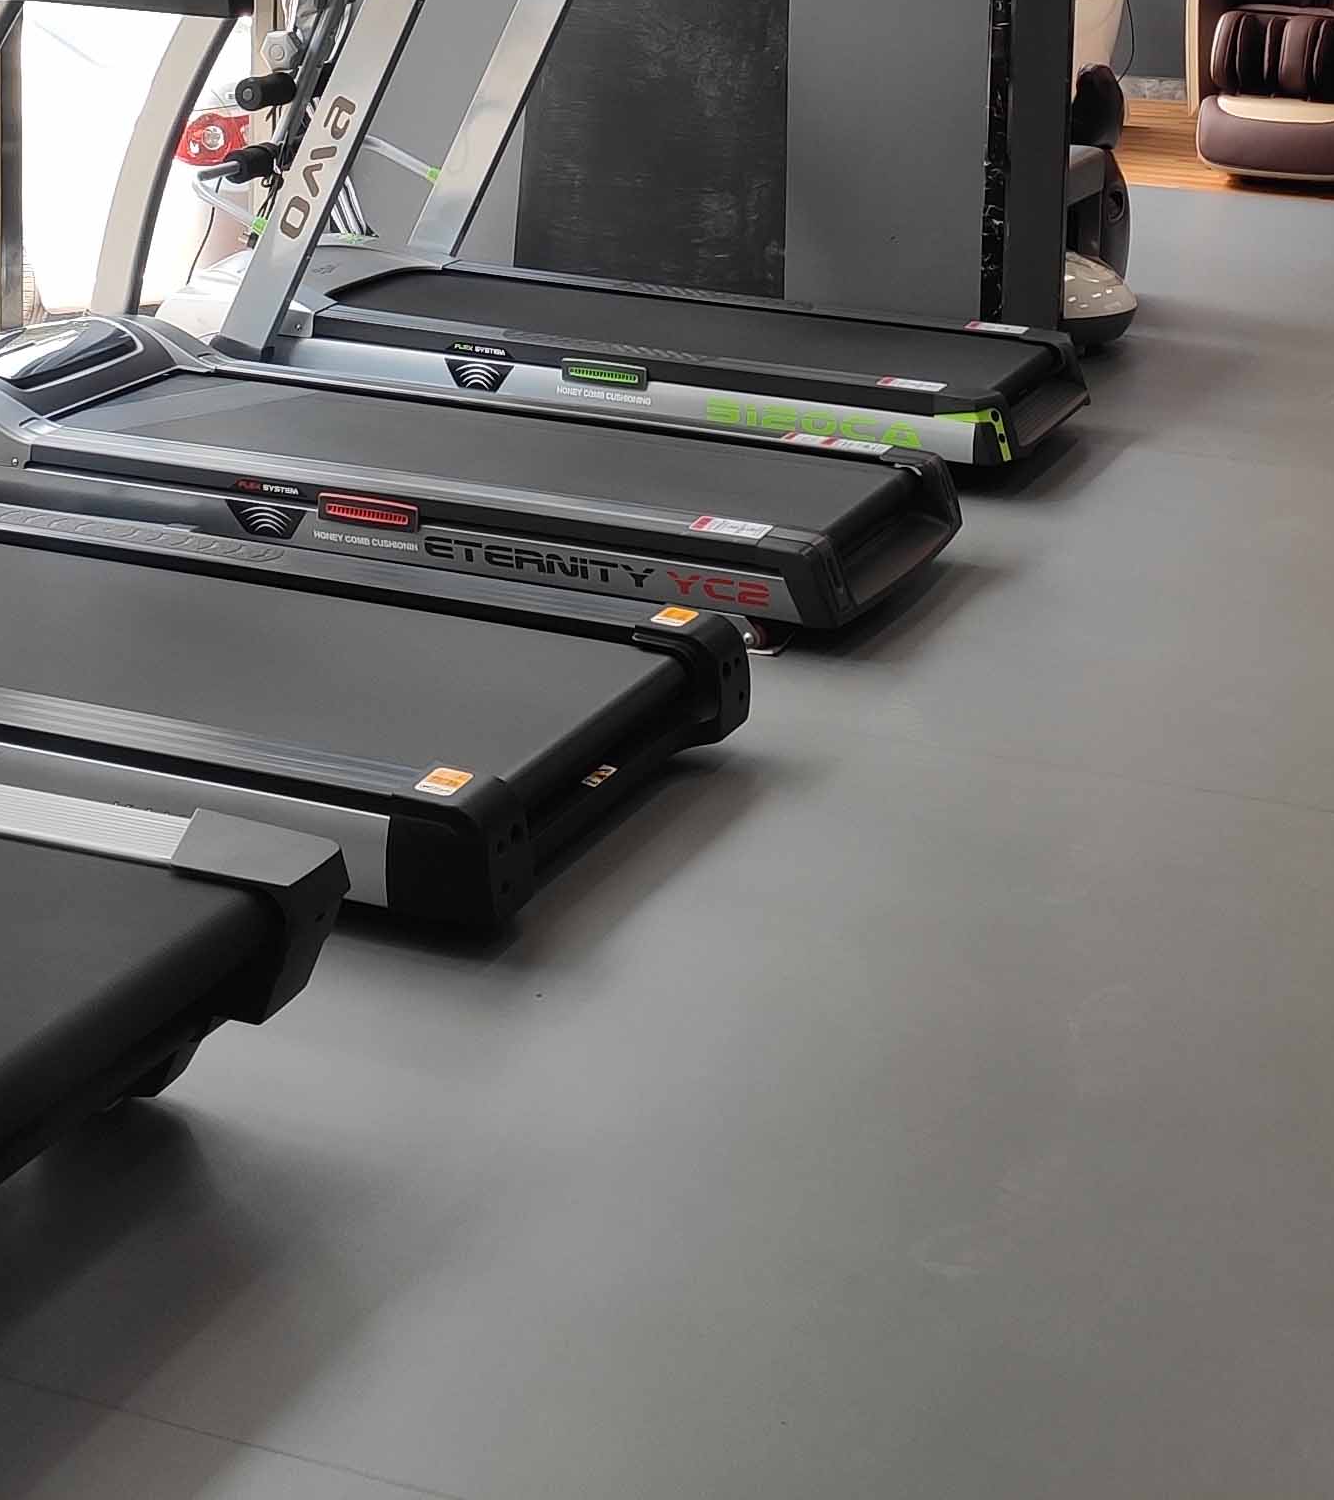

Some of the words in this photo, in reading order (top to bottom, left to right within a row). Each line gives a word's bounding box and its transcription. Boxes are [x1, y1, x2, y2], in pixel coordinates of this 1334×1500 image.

[474, 345, 506, 357] SYSTEM
[556, 385, 583, 398] HONEY
[262, 484, 299, 496] SYSTEM
[313, 530, 344, 543] HONEY
[423, 535, 655, 589] ETERNITY
[667, 571, 771, 607] YC2
